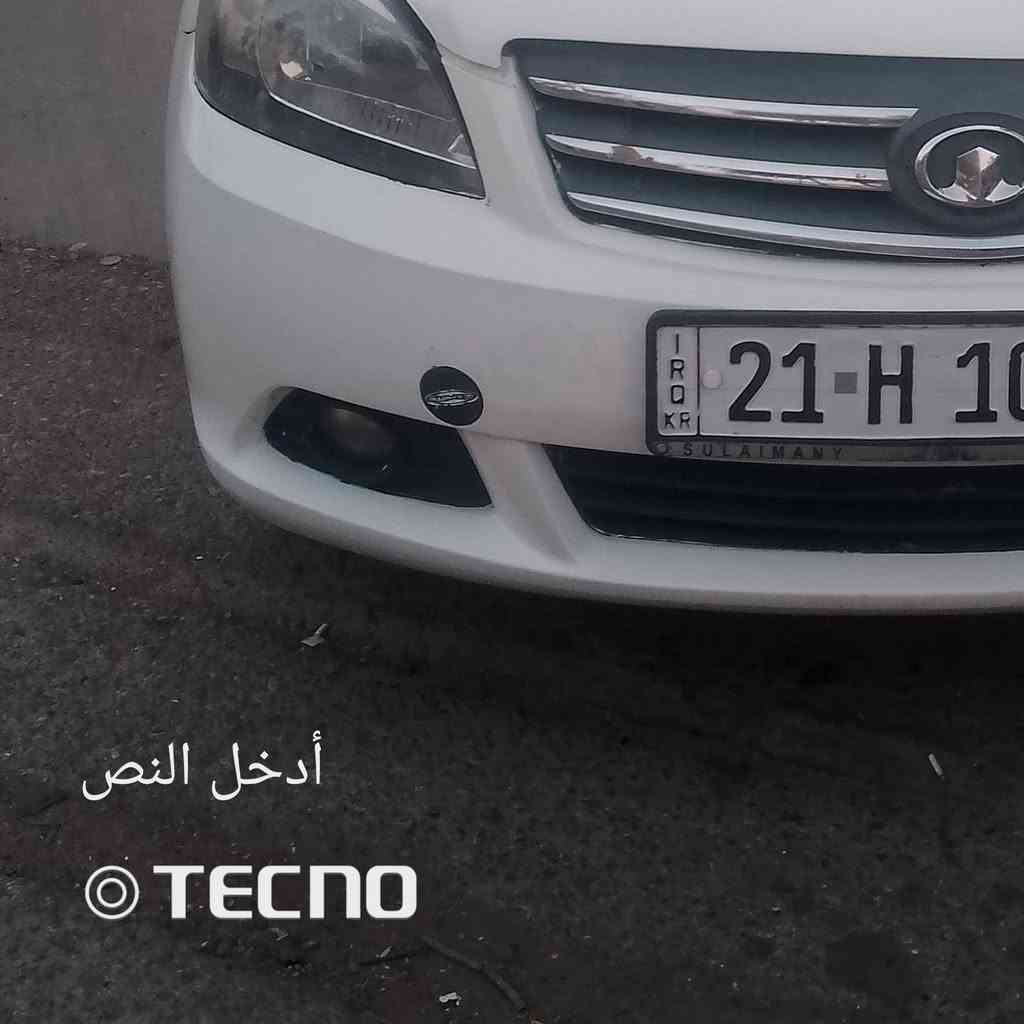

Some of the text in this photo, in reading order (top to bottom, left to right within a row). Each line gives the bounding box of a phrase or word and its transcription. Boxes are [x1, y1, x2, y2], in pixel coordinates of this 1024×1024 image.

[671, 333, 684, 404] IRQ
[728, 340, 824, 424] 21
[866, 343, 915, 424] H
[664, 412, 690, 429] KR
[683, 442, 842, 460] SULAIMANY
